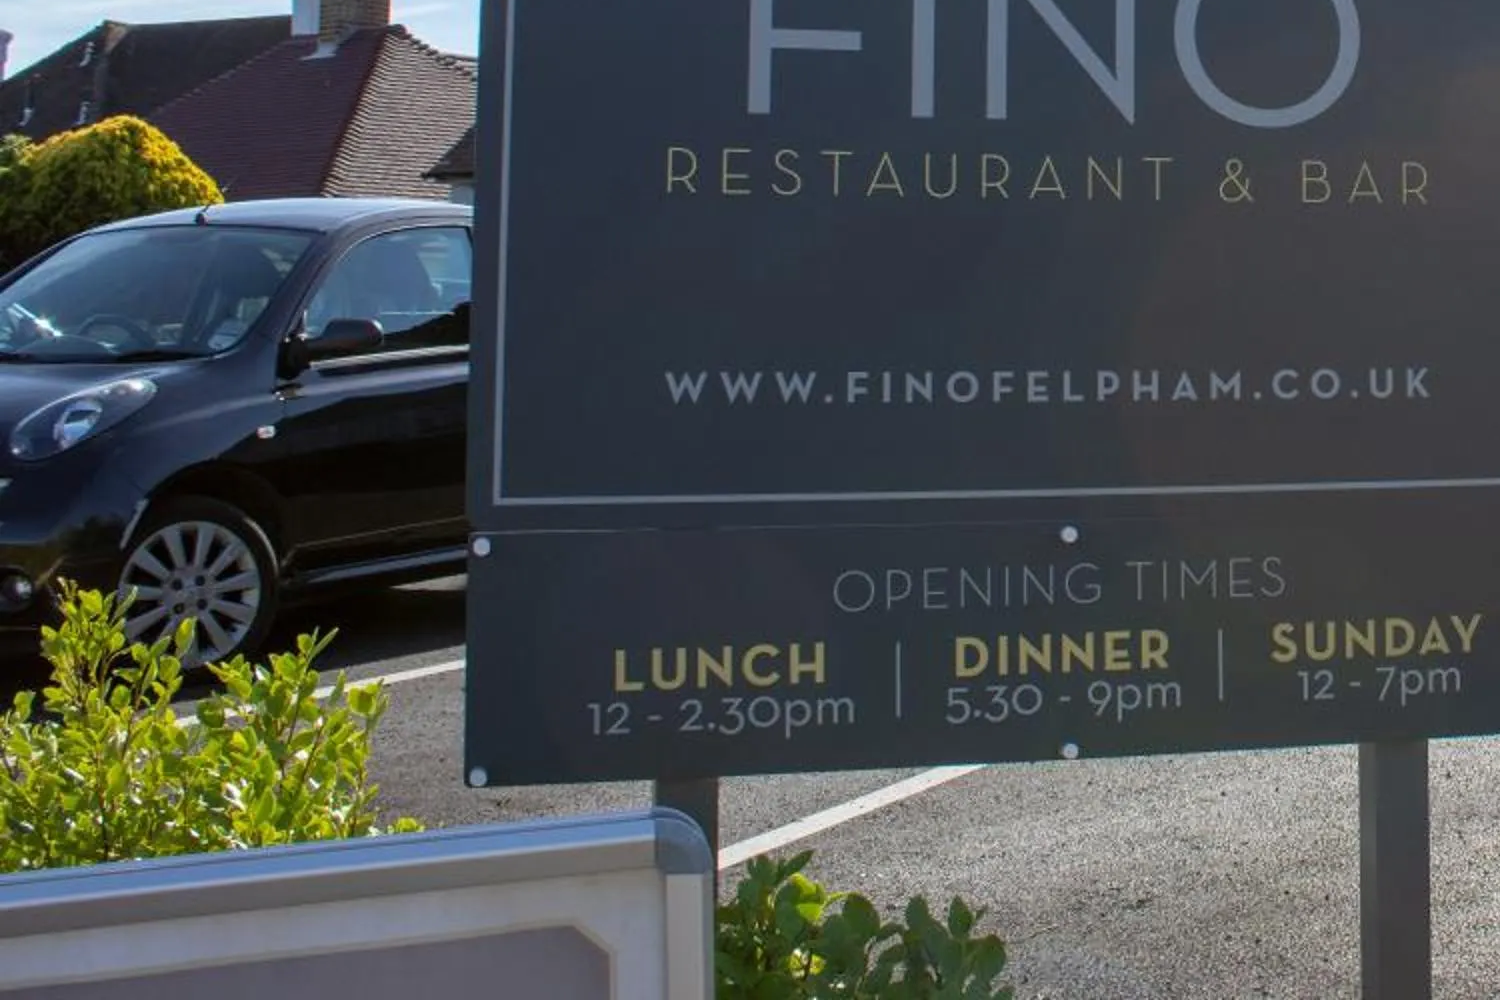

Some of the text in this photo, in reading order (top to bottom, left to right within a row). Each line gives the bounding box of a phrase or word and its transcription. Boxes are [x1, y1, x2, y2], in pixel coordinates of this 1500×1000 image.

[665, 146, 1430, 205] RESTAURANT & BAR
[664, 365, 1431, 405] WWW.FINOFELPHAM.CO.UK
[832, 556, 1287, 613] OPENING TIMES
[955, 629, 1170, 677] DINNER
[1270, 613, 1483, 663] SUNDAY
[614, 642, 827, 692] LUNCH
[1297, 668, 1337, 702] 12
[1375, 664, 1462, 704] 7pm
[587, 701, 633, 736] 12
[679, 694, 856, 739] 2.30pm
[945, 683, 1044, 725] 5.30
[1087, 678, 1183, 723] 9pm
